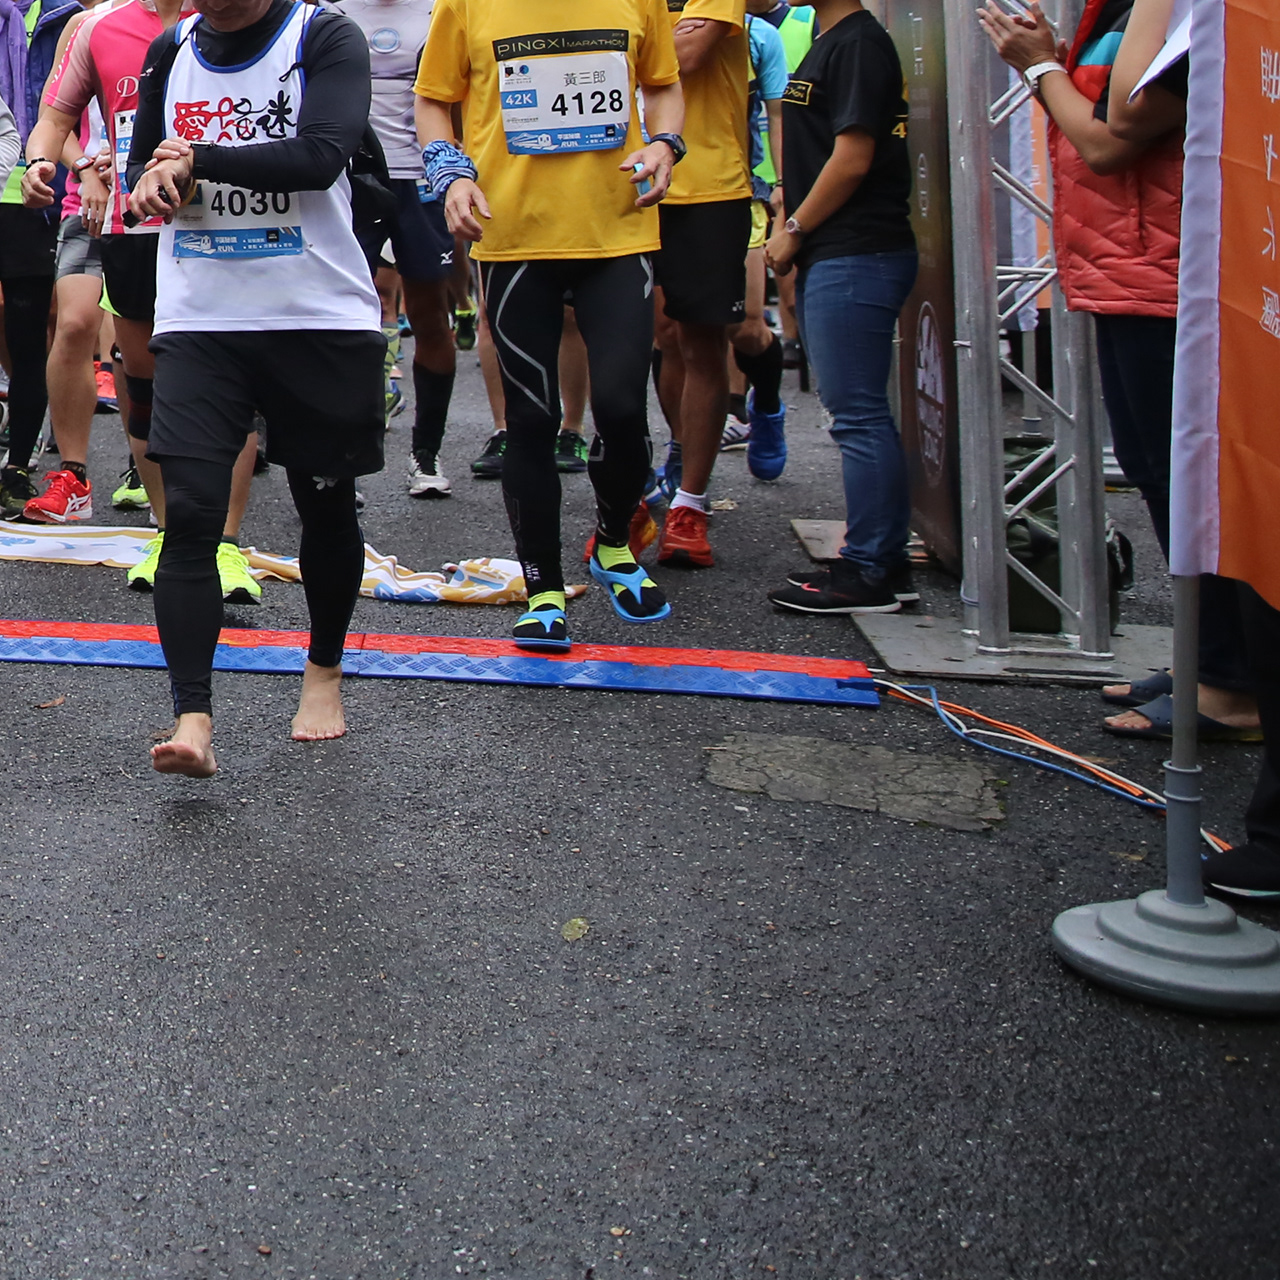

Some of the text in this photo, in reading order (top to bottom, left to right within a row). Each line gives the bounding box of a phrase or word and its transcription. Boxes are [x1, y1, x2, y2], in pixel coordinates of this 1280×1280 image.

[497, 37, 626, 55] PINGXI MARATHON
[563, 70, 606, 87] 黃三郎
[506, 93, 533, 105] 42K
[551, 89, 624, 116] 4128
[211, 189, 290, 217] 4030
